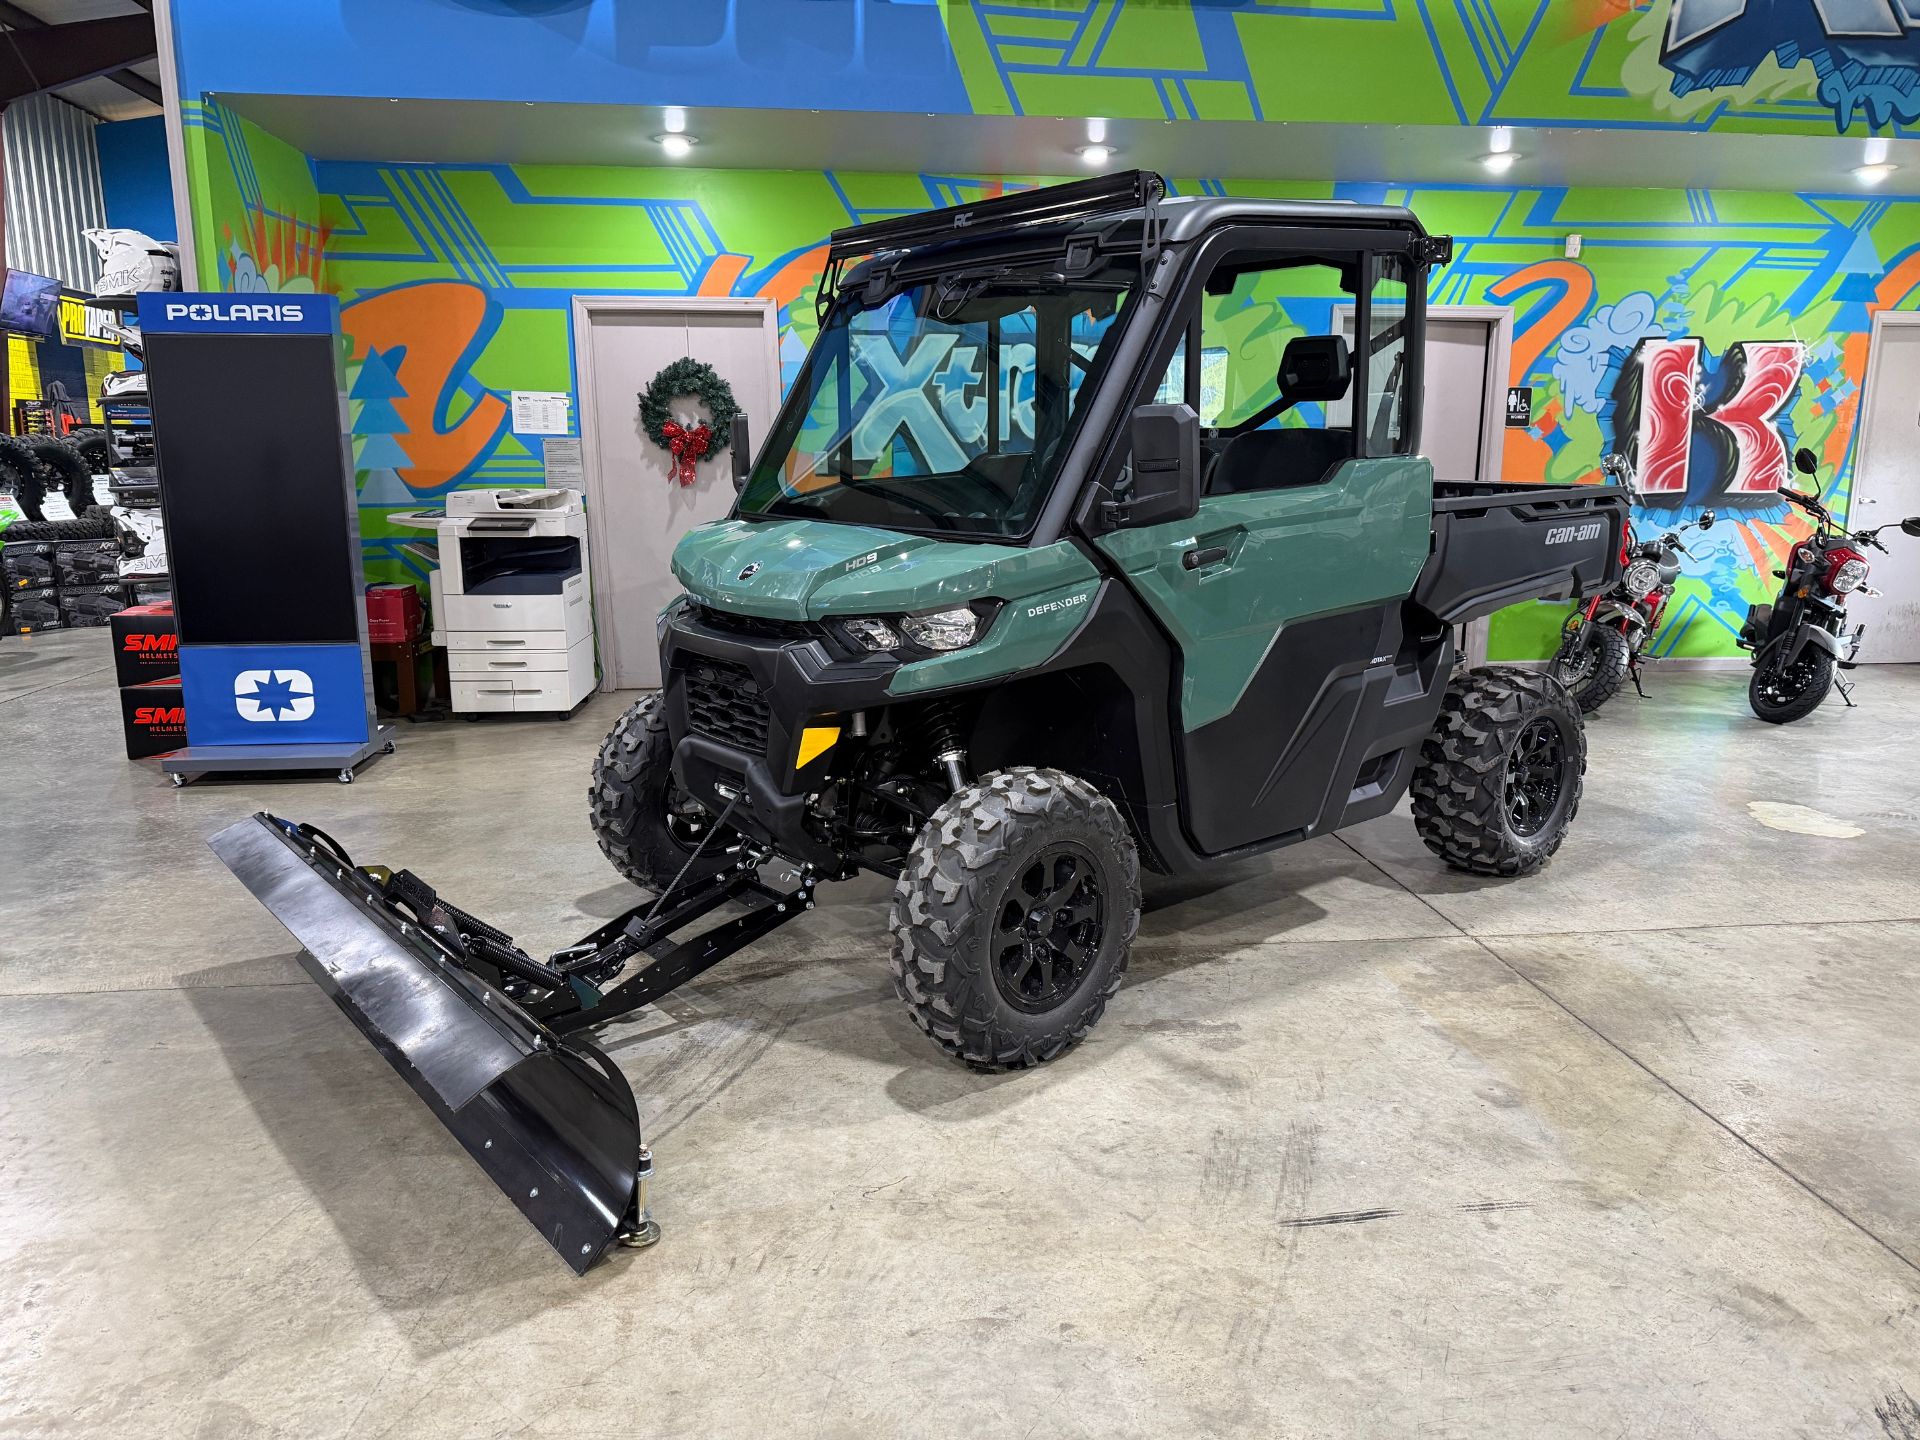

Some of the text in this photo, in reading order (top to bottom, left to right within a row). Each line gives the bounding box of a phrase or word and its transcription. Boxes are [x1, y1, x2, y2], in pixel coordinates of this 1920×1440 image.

[953, 212, 974, 228] RC
[166, 304, 304, 322] POLARIS
[1544, 523, 1601, 545] can-am
[134, 553, 168, 571] SM
[845, 552, 878, 572] HD9
[1027, 594, 1088, 617] DEFENDER
